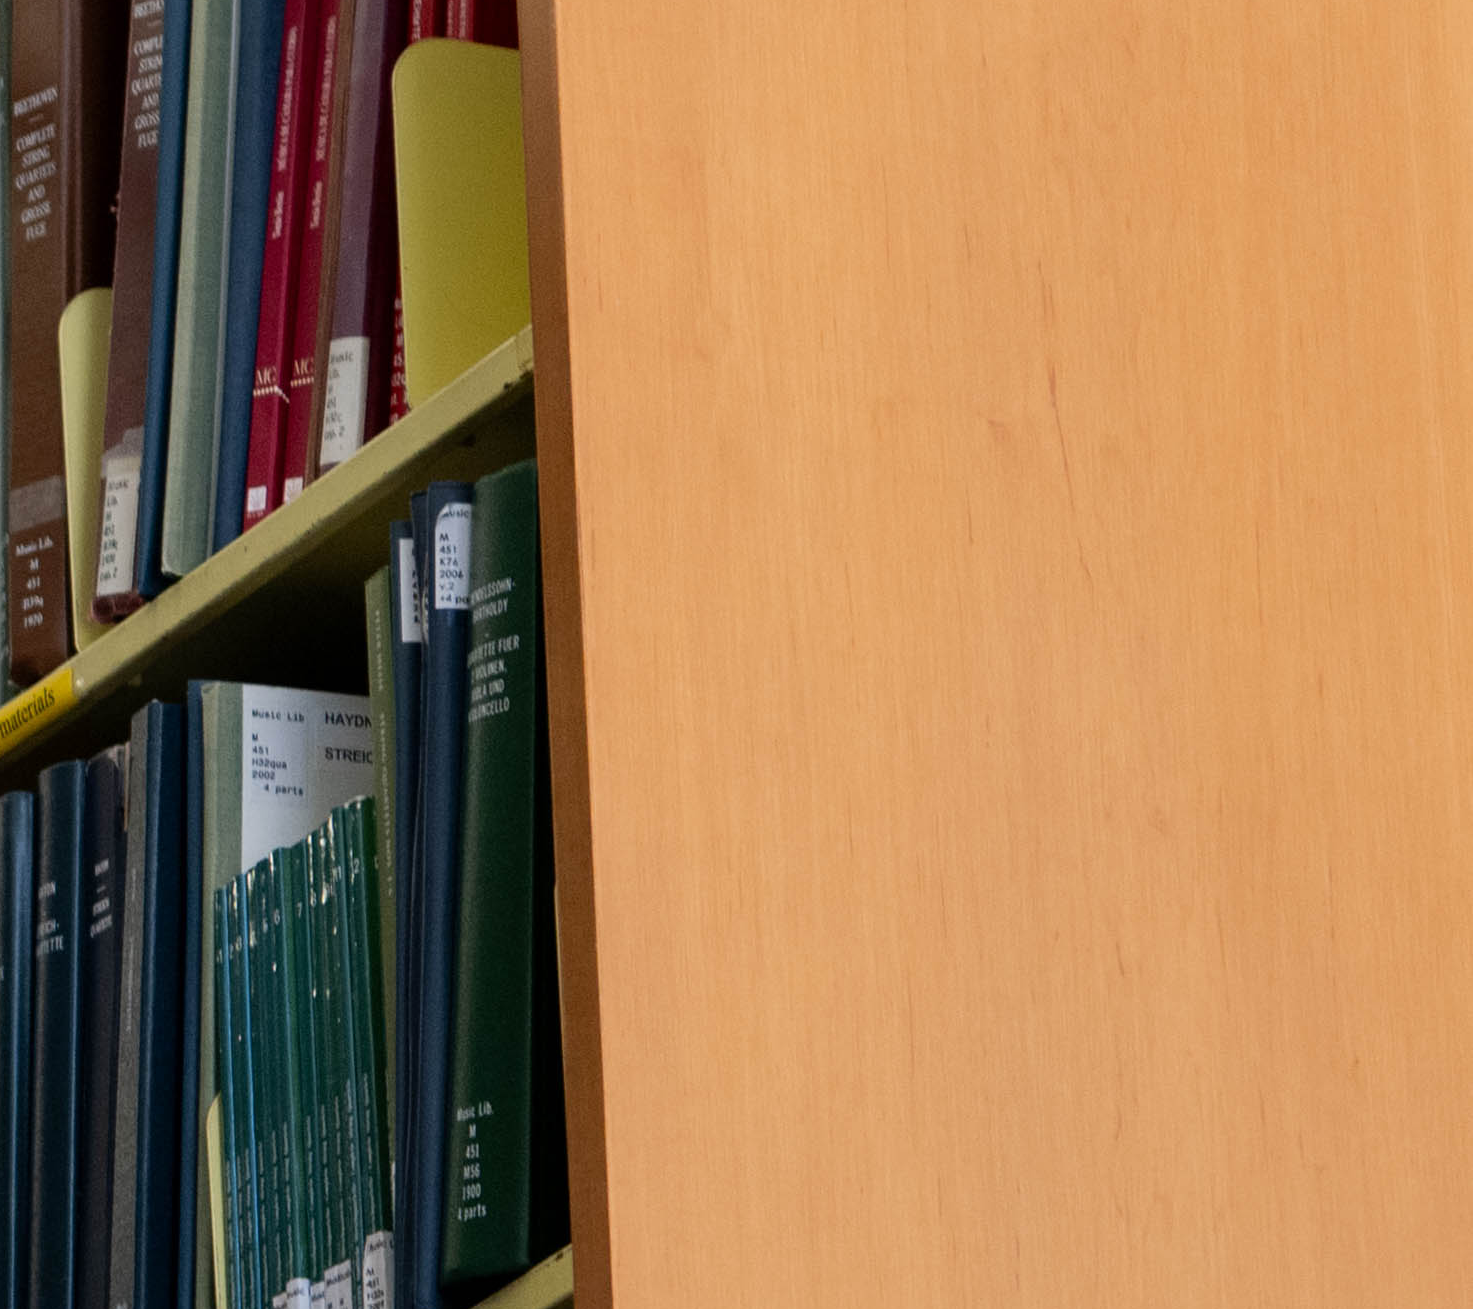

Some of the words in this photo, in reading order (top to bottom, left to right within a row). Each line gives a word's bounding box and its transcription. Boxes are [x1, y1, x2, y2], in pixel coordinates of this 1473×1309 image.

[13, 85, 58, 117] BEETHOVEN
[15, 121, 57, 153] COMPLETE
[21, 144, 51, 169] STRING
[15, 161, 57, 191] QUARTETS
[28, 183, 46, 203] AND
[20, 200, 51, 225] GROSSE
[26, 220, 47, 241] FUGE
[439, 532, 449, 541] M
[439, 545, 457, 554] 451
[439, 557, 459, 567] K76
[439, 570, 464, 579] 2006
[497, 634, 521, 655] FUER
[488, 678, 505, 695] UND
[251, 709, 282, 721] Music
[287, 711, 305, 722] Lib
[324, 711, 372, 728] HAYDN
[251, 733, 259, 742] M
[251, 746, 269, 754] 451
[251, 758, 288, 770] H32qua
[251, 770, 276, 780] 2002
[275, 785, 304, 797] parts
[468, 1123, 477, 1138] M
[465, 1143, 479, 1159] 451
[463, 1162, 480, 1179] M56
[462, 1183, 482, 1201] 1900
[464, 1203, 487, 1222] parts
